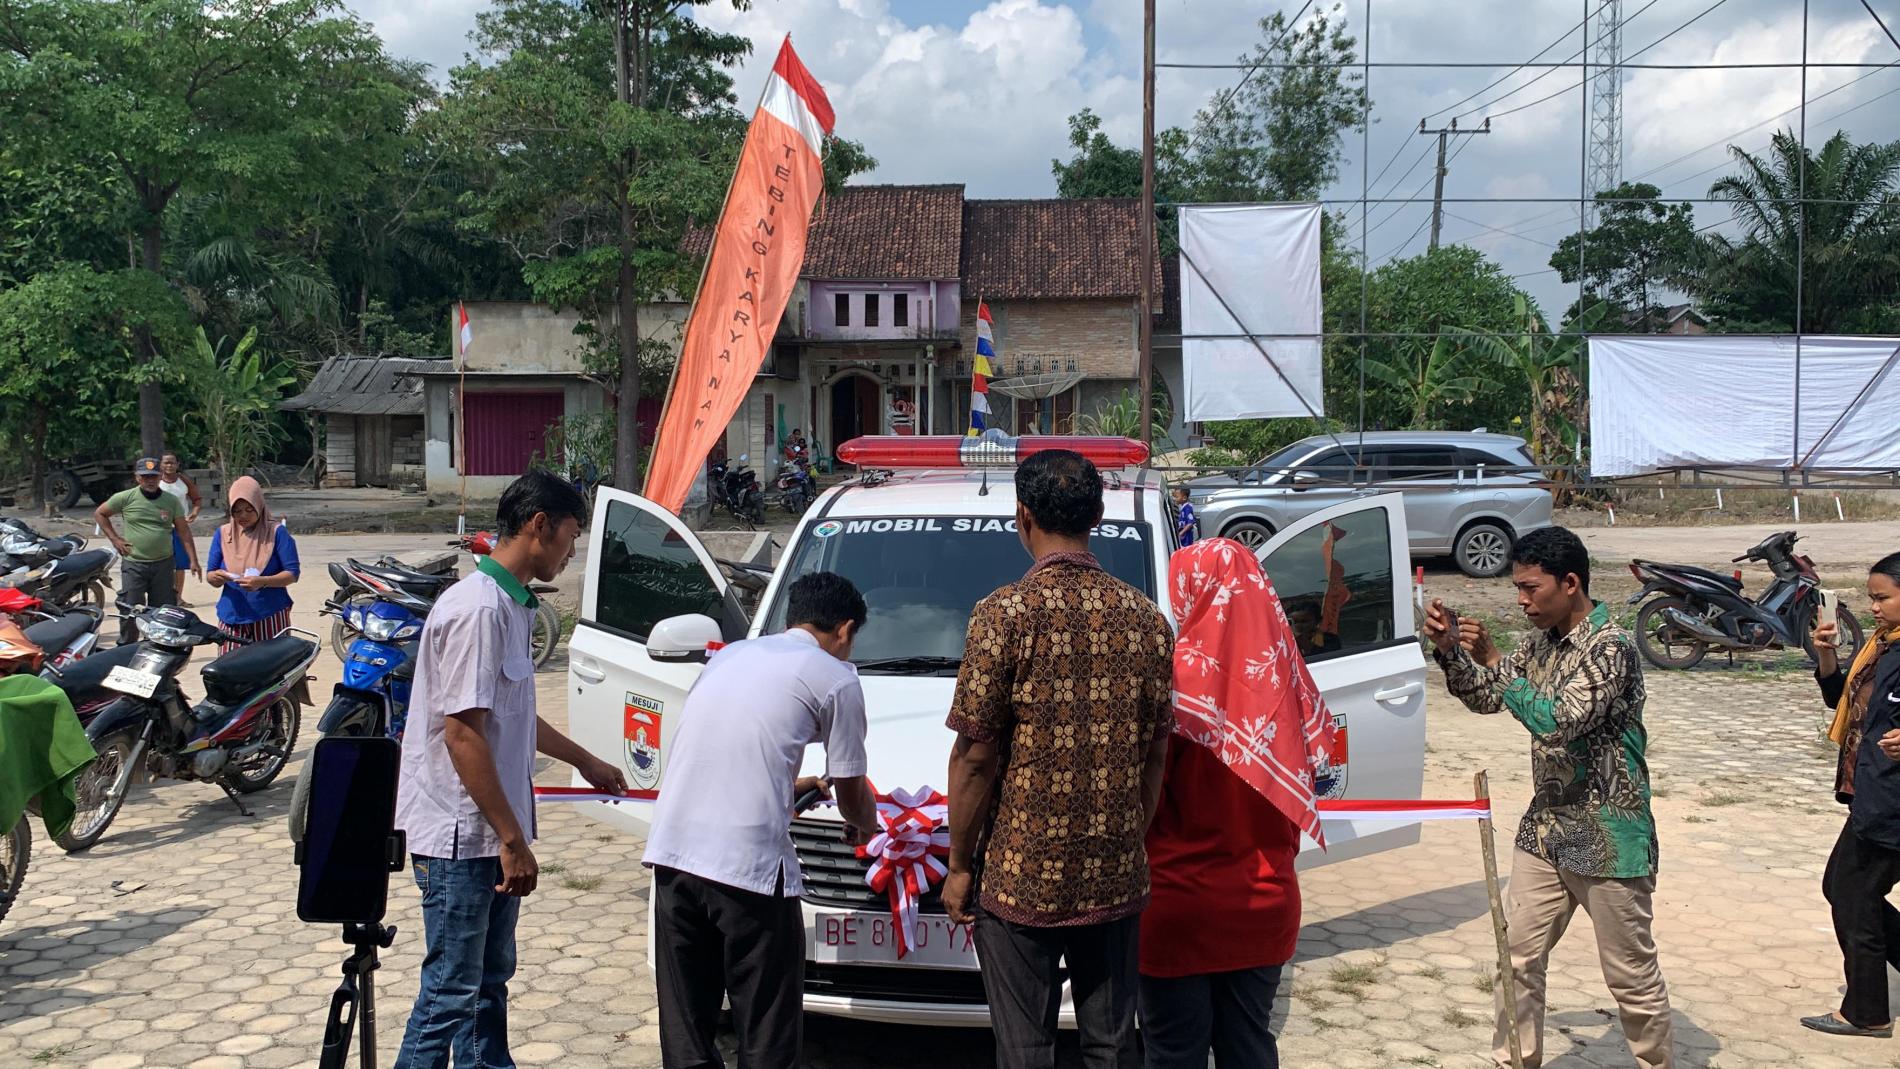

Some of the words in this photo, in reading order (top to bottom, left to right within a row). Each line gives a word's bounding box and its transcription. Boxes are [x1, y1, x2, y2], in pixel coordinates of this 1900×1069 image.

[752, 143, 796, 256] TEBING
[845, 518, 942, 534] MOBIL
[952, 518, 1018, 533] SIA
[1089, 523, 1142, 541] SA
[631, 696, 659, 711] MESUJI
[826, 918, 856, 946] BE
[872, 919, 928, 948] 810
